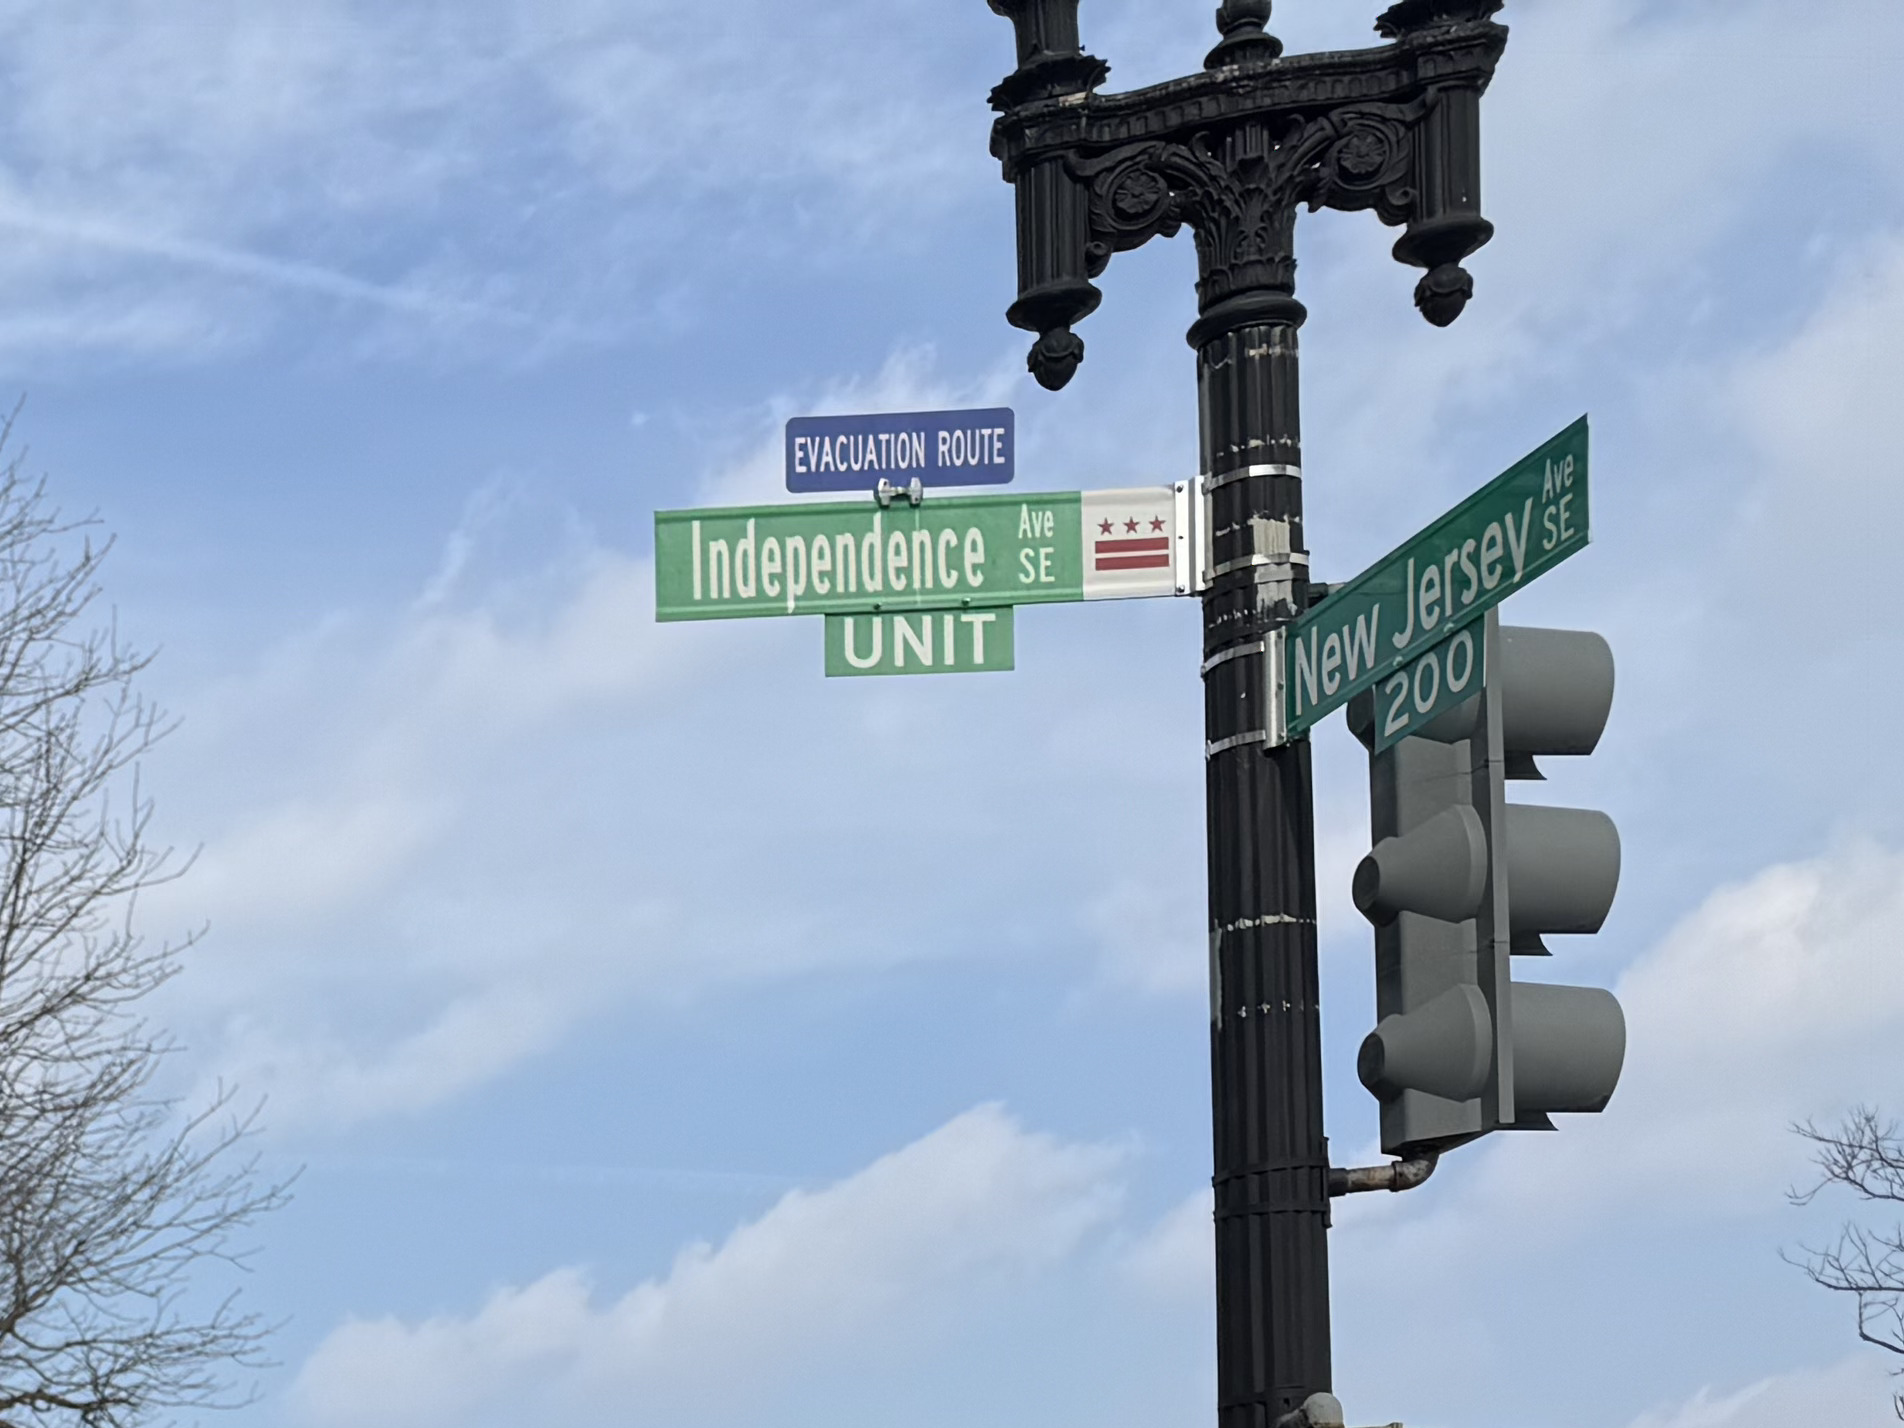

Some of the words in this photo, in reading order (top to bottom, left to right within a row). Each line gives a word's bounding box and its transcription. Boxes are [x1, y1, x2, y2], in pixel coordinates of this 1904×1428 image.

[794, 431, 925, 473] EVACUATION
[938, 427, 1005, 467] ROUTE
[1542, 453, 1574, 504] Ave
[1018, 503, 1054, 539] Ave
[1543, 493, 1575, 550] SE
[692, 511, 985, 613] Independence
[1018, 546, 1055, 584] SE
[1295, 603, 1380, 715] New
[1392, 497, 1534, 649] Jersey
[843, 613, 996, 669] UNIT
[1384, 629, 1473, 737] 200
